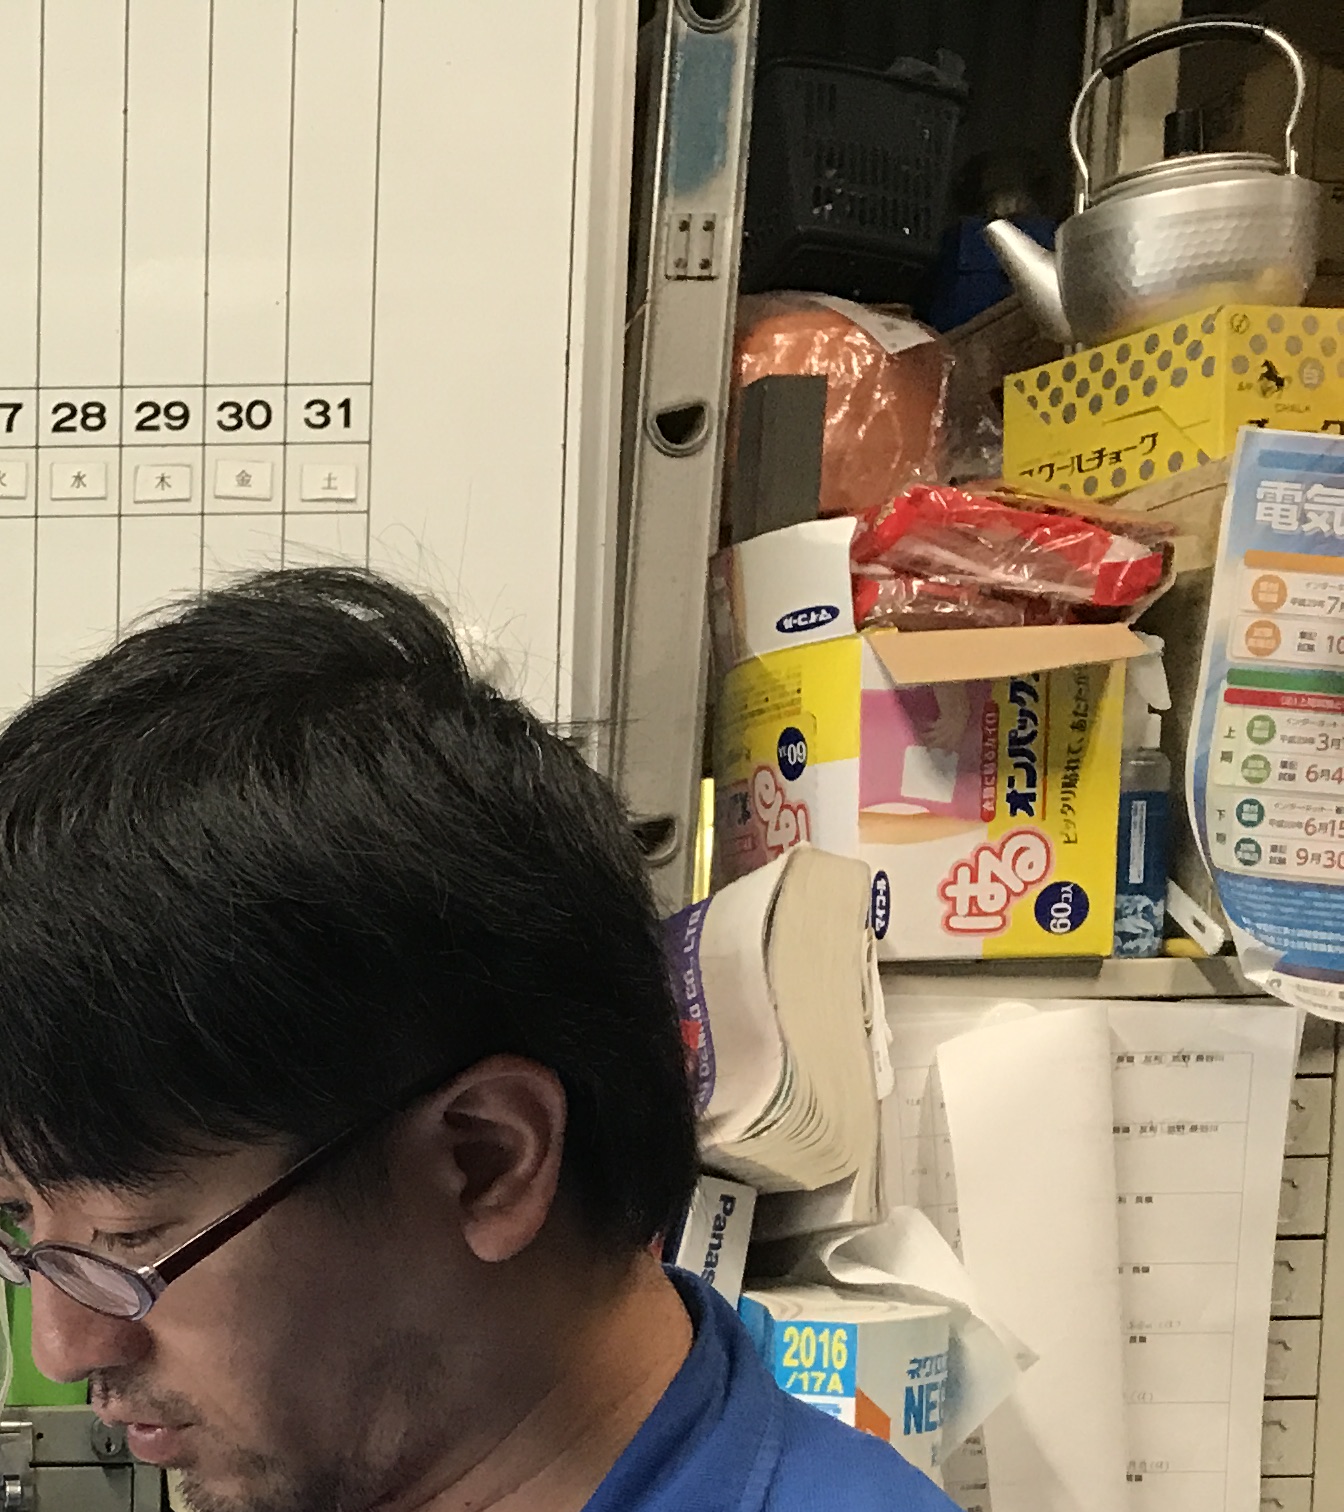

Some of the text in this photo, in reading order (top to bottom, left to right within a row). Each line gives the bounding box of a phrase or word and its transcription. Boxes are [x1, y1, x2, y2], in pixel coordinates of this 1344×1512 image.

[52, 401, 106, 432] 28
[135, 401, 190, 431] 29
[217, 399, 272, 431] 30
[304, 398, 351, 429] 31
[71, 471, 87, 488] 水
[155, 473, 172, 490] 木
[235, 470, 252, 488] 金
[322, 473, 338, 490] 土
[783, 1326, 848, 1370] 2016
[786, 1372, 844, 1395] /17A
[904, 1382, 946, 1436] NE
